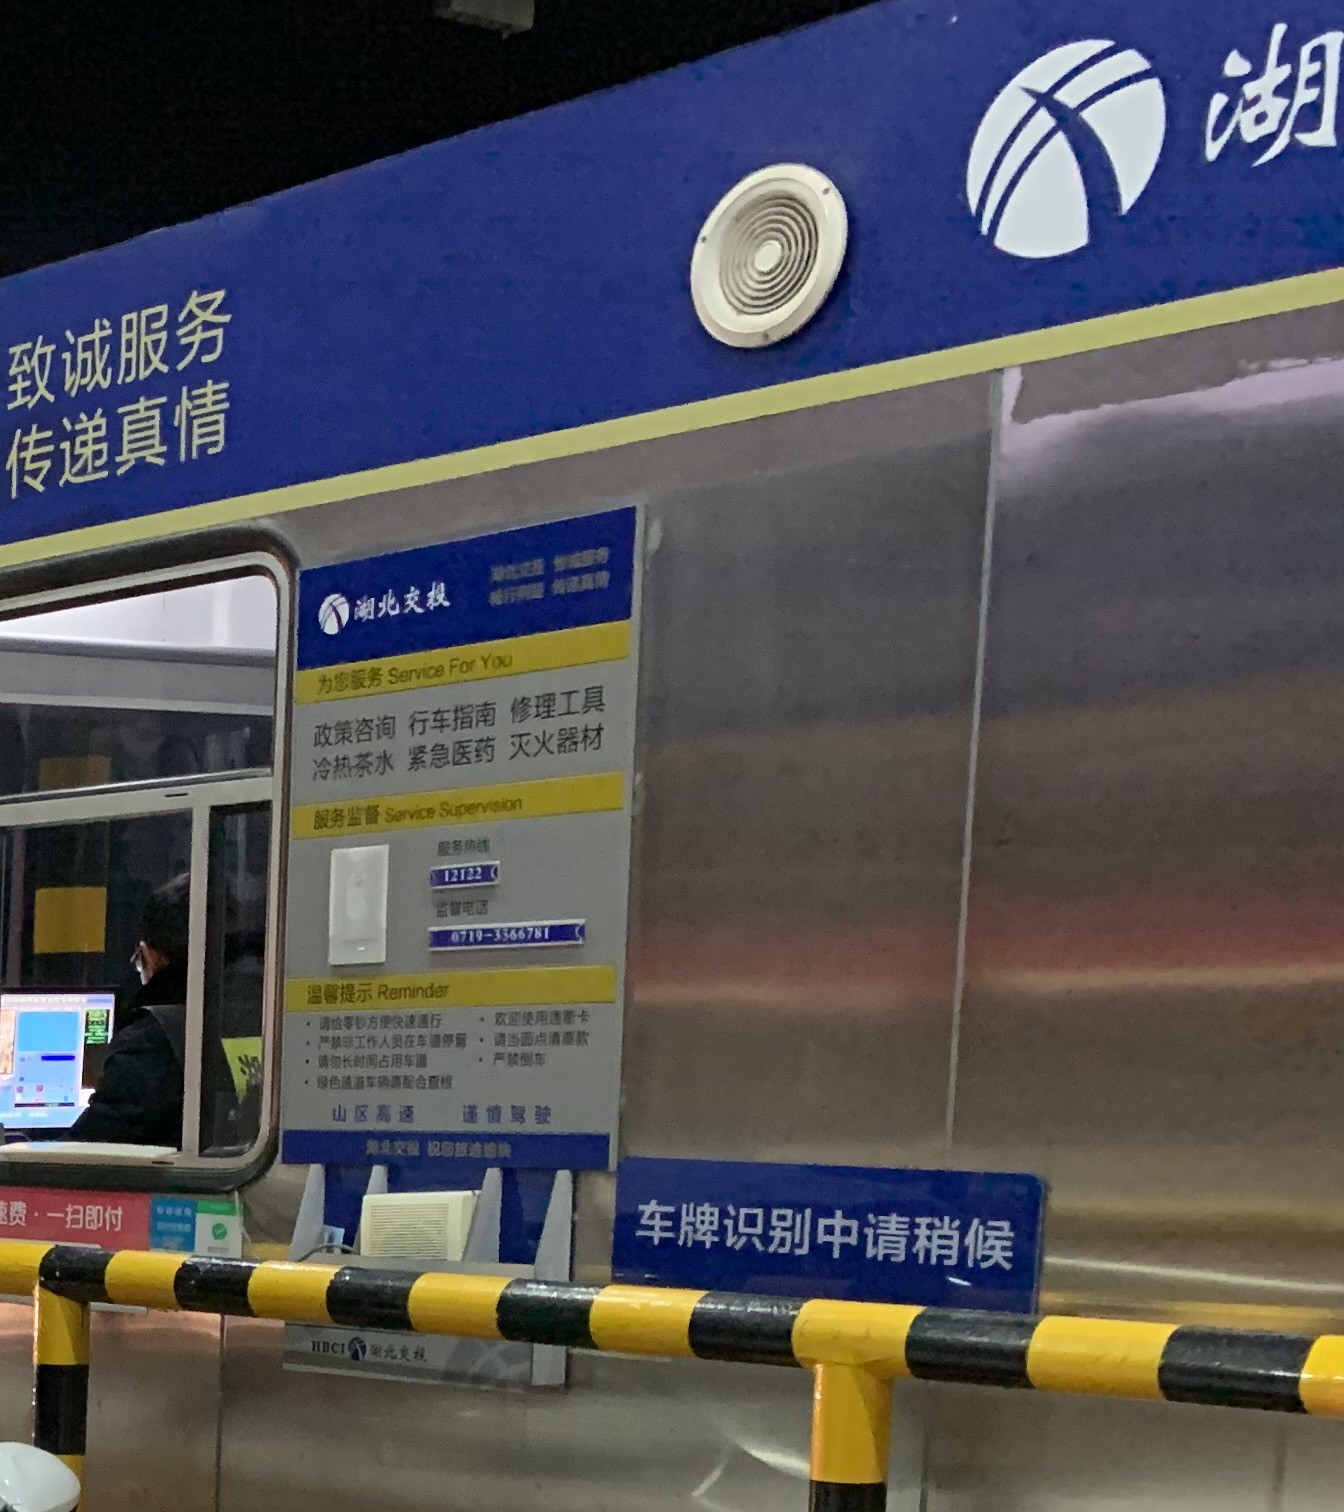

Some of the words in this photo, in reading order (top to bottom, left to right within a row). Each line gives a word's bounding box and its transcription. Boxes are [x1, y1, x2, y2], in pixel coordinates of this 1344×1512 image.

[1205, 23, 1344, 167] 湖
[6, 289, 233, 412] 致诚服务
[4, 379, 231, 499] 传递真情
[353, 581, 451, 622] 湖北交投
[317, 667, 385, 694] 为您服务
[387, 662, 446, 686] Service
[449, 657, 476, 675] For
[479, 652, 514, 670] You
[313, 715, 397, 748] 政策咨询
[408, 701, 497, 737] 行车指南
[510, 685, 607, 724] 修理工具
[312, 749, 395, 782] 冷热茶水
[407, 736, 497, 772] 紧急医药
[509, 722, 605, 761] 灭火器材
[313, 804, 380, 831] 服务监督
[384, 805, 436, 823] Service
[438, 795, 524, 819] Supervision
[443, 866, 483, 882] 12122
[307, 983, 375, 1005] 温馨提示
[377, 982, 450, 1000] Reminder
[332, 1104, 414, 1123] 山区高速
[462, 1104, 551, 1124] 谨慎驾驶
[634, 1198, 1016, 1271] 车牌识别中请稍候
